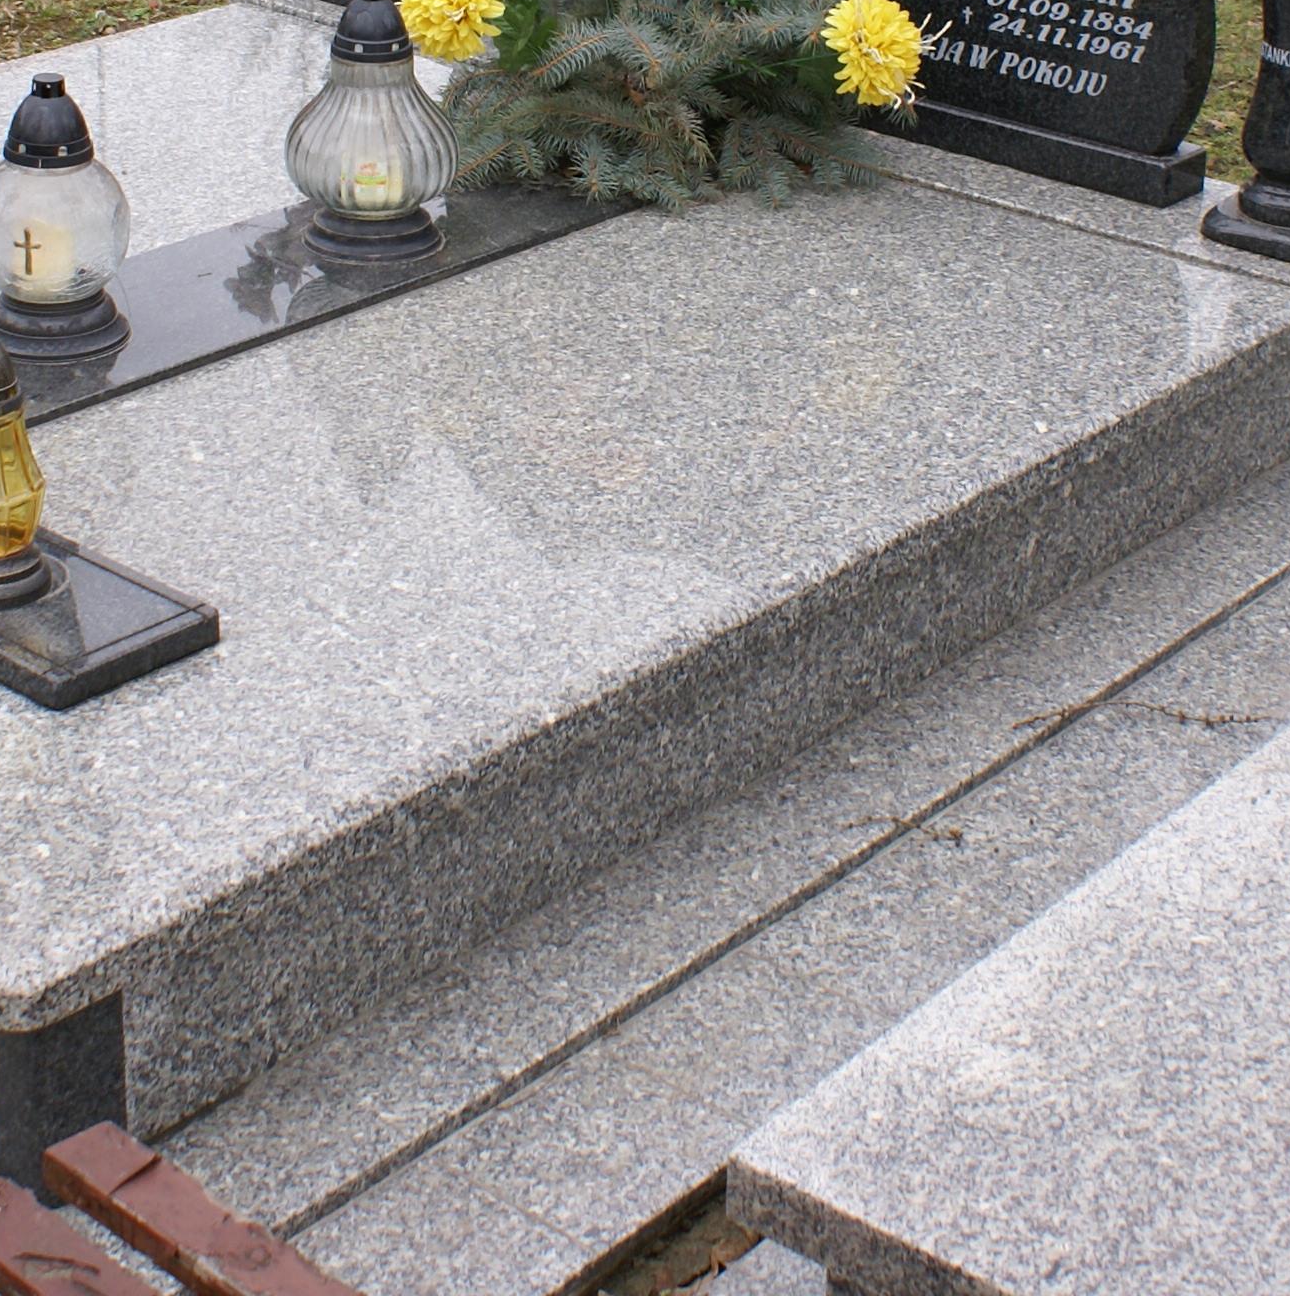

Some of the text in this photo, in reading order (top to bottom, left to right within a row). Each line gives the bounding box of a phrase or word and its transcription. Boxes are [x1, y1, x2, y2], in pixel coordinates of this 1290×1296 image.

[988, 12, 1147, 64] 24.11.1961
[969, 44, 999, 70] W
[999, 51, 1108, 97] POKOJU
